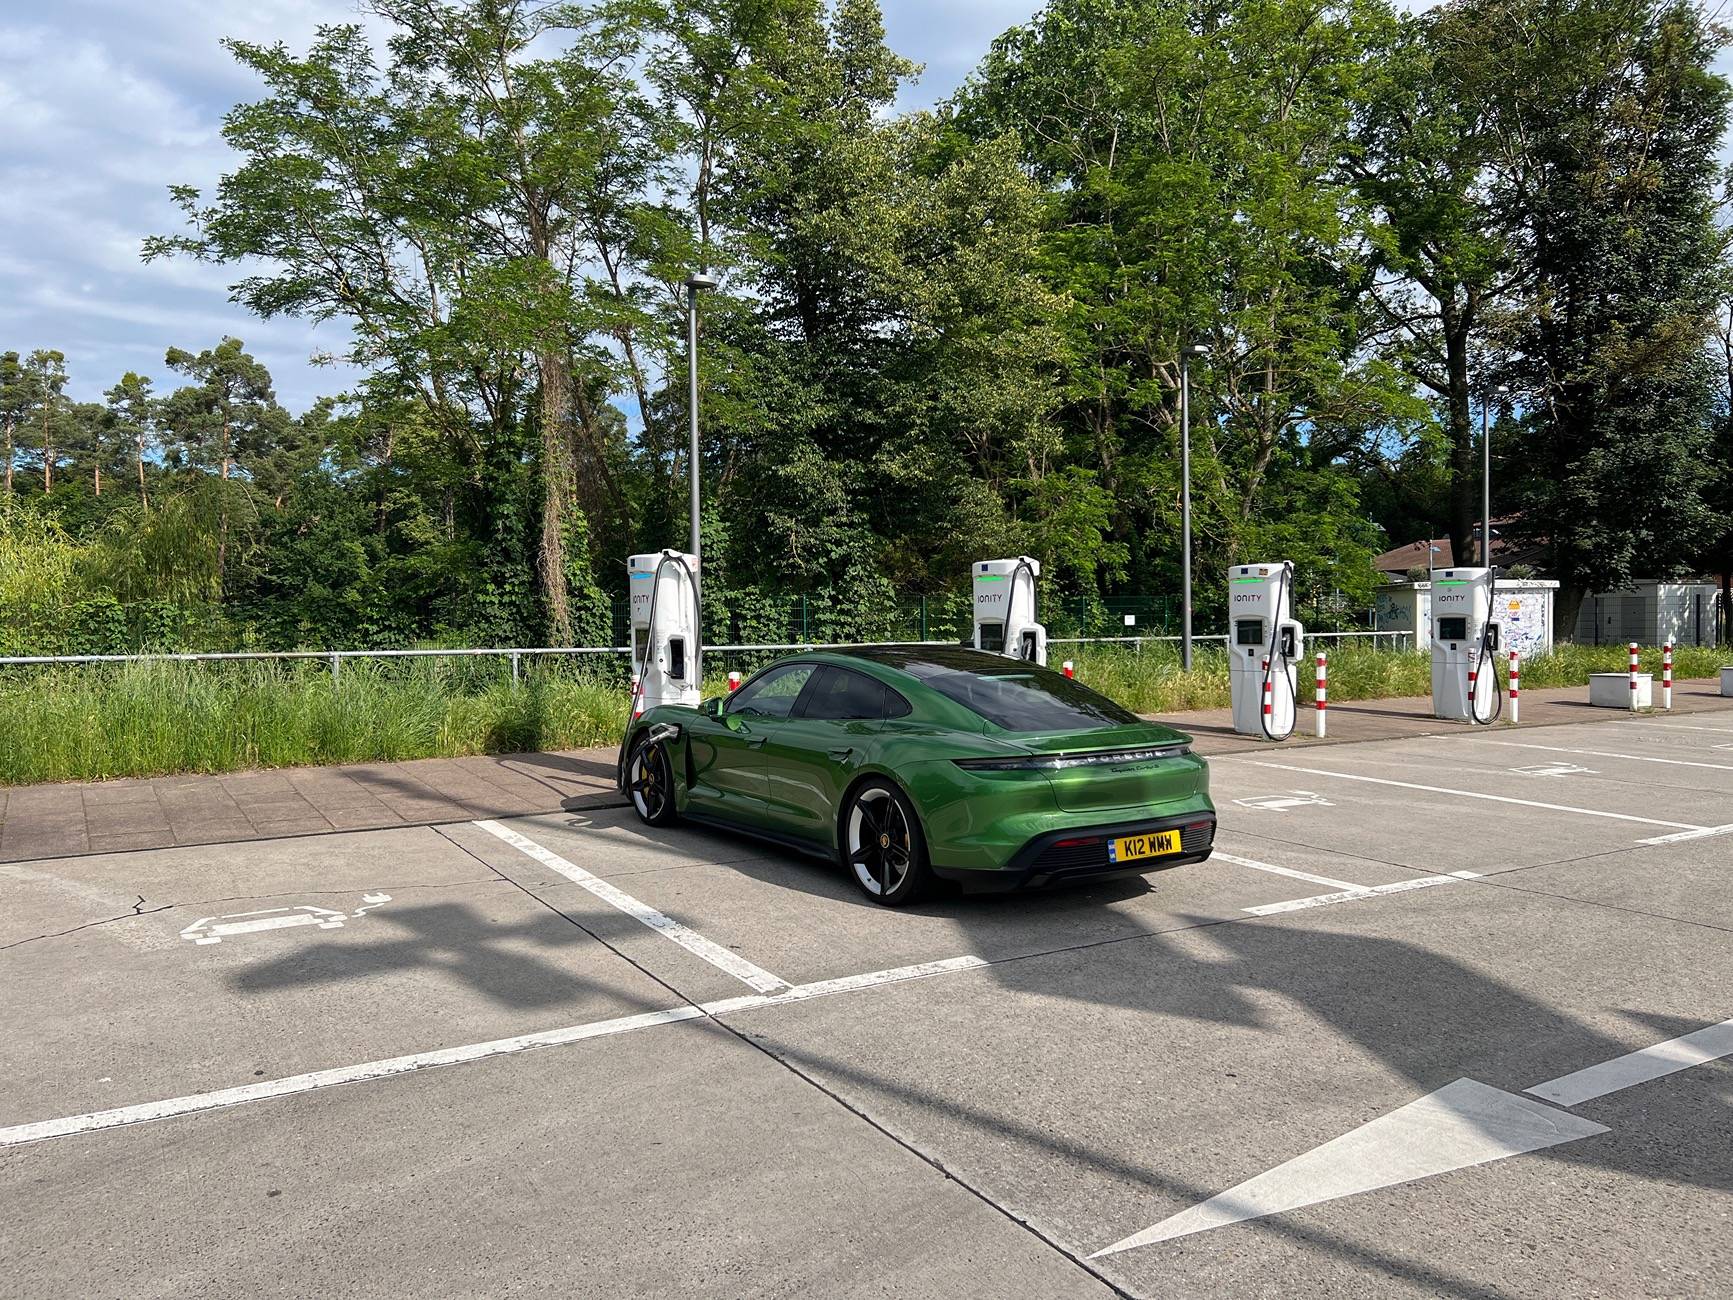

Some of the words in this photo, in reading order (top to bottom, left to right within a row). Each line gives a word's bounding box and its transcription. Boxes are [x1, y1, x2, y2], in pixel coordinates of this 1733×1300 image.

[977, 593, 1003, 604] IONITY
[1234, 594, 1262, 602] IONITY
[1438, 594, 1465, 602] IONITY
[1124, 838, 1146, 857] K12
[1148, 834, 1173, 853] WMW
